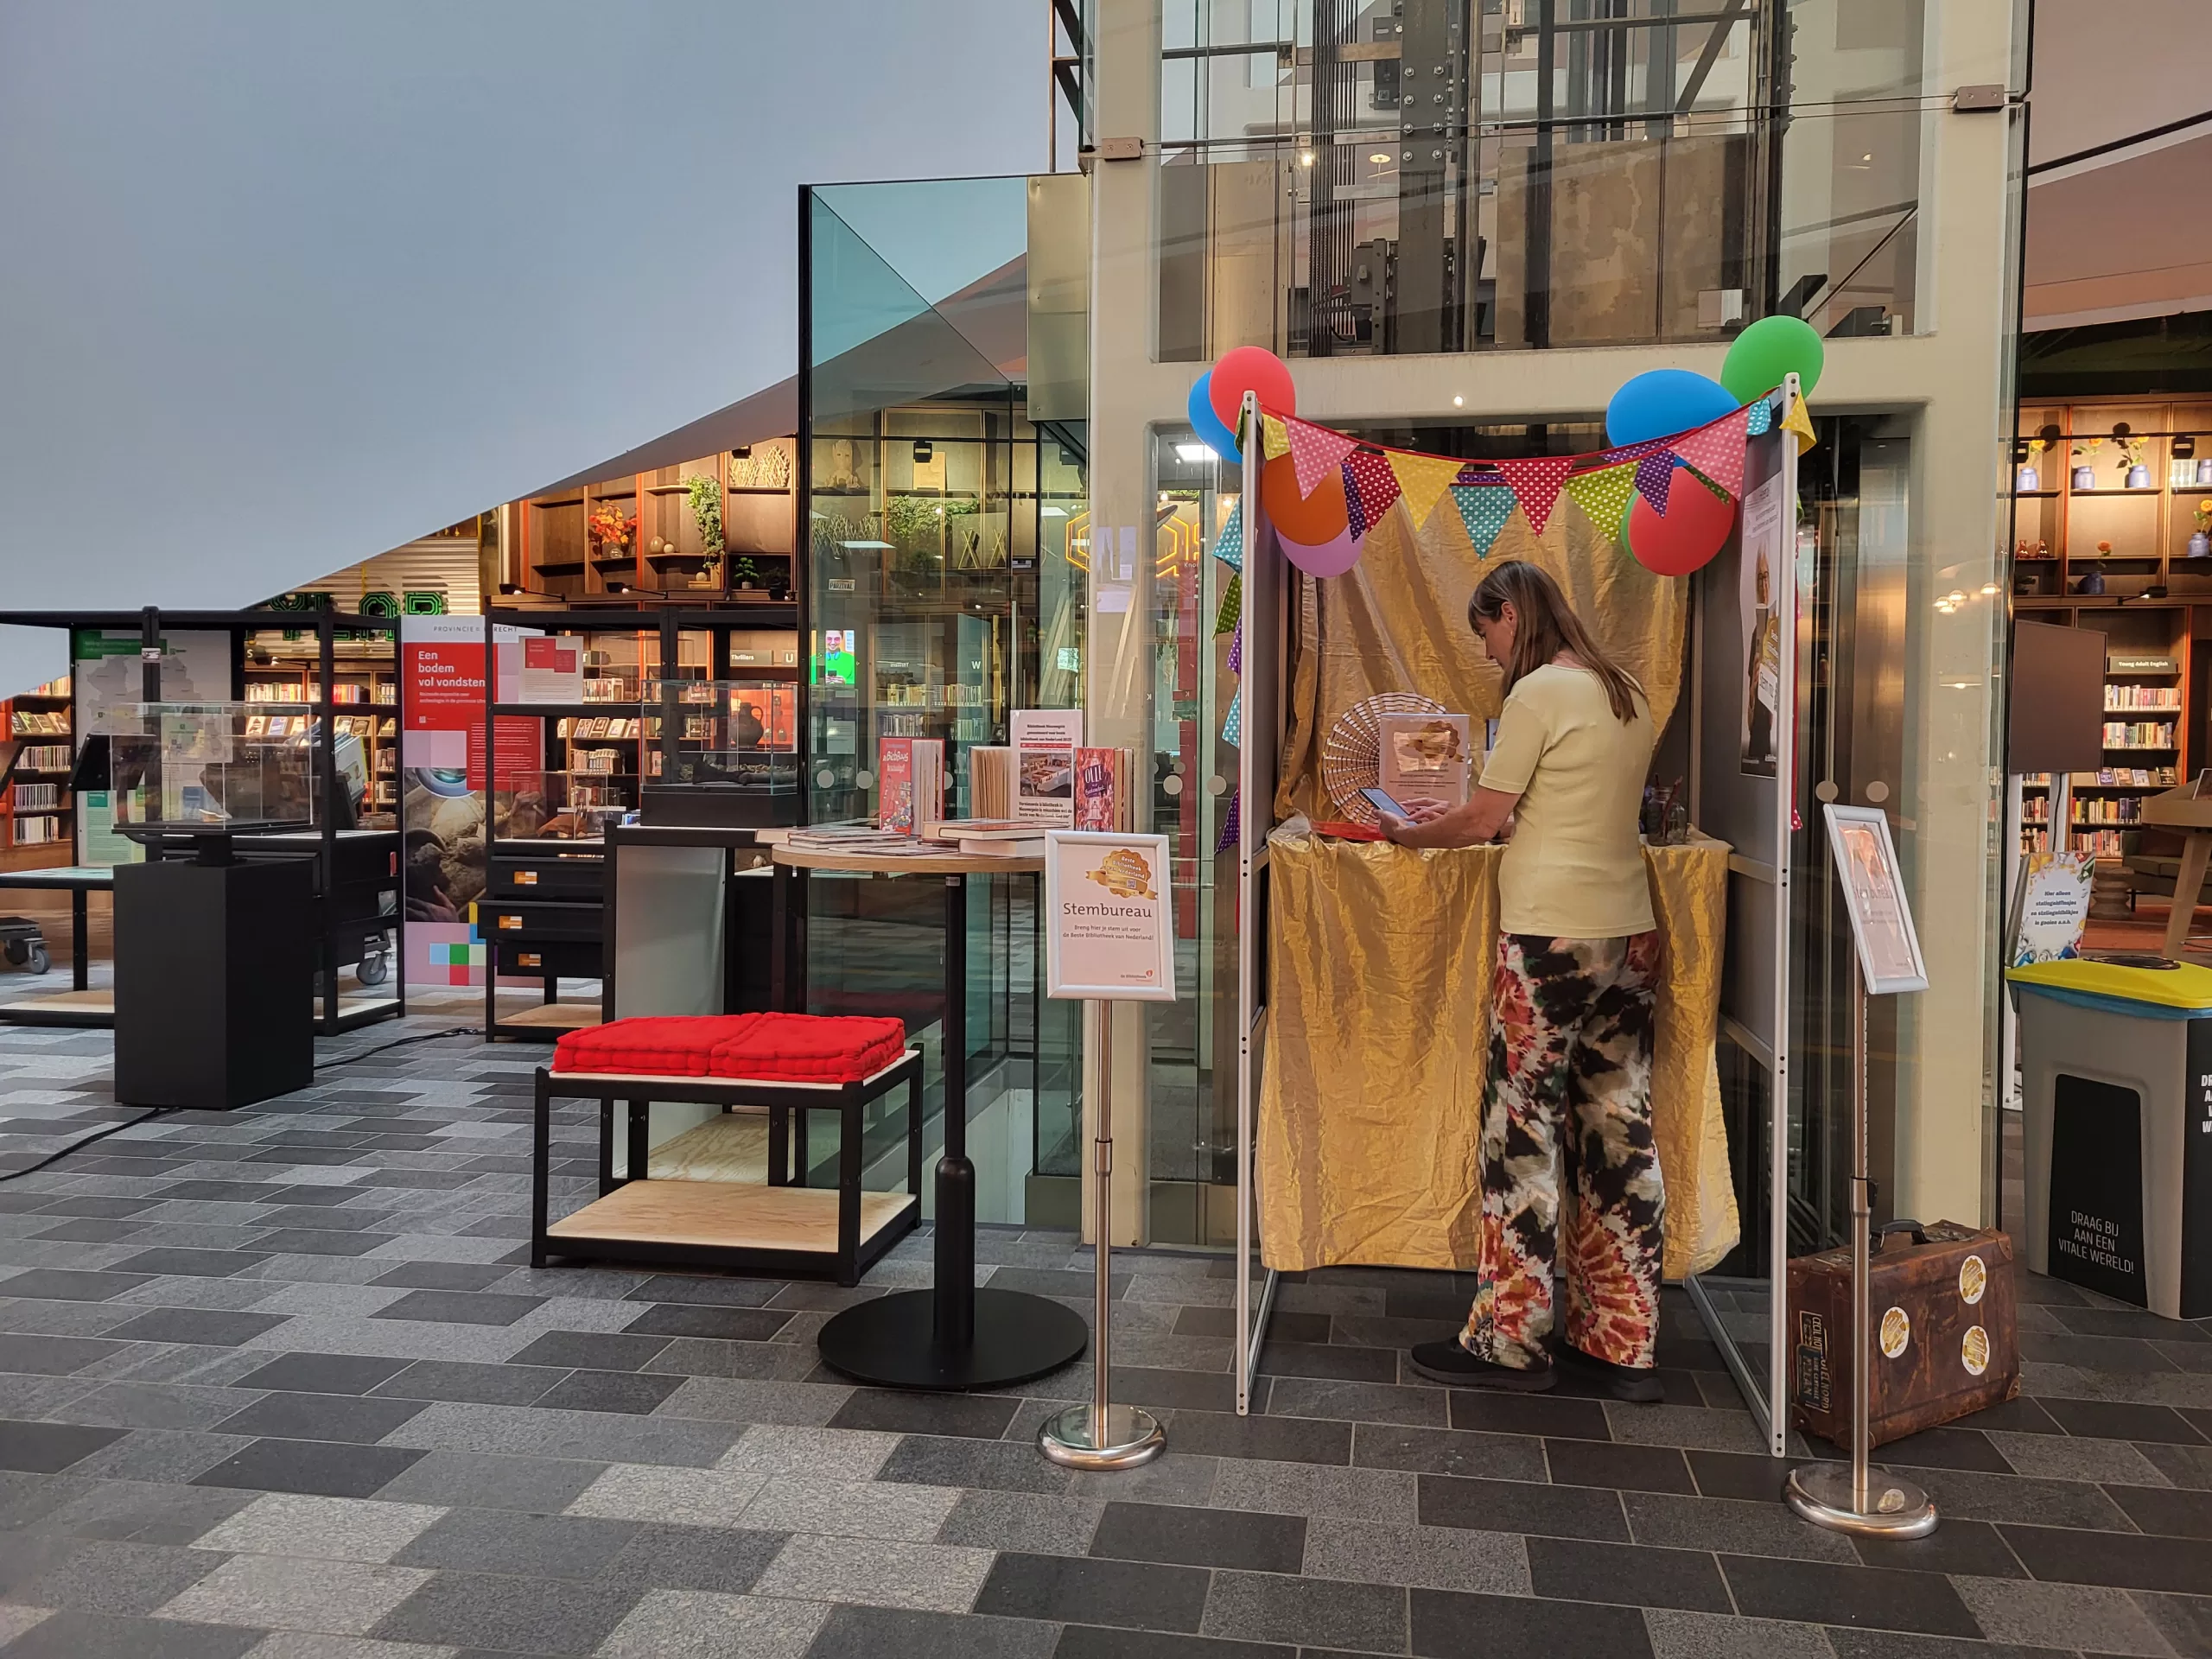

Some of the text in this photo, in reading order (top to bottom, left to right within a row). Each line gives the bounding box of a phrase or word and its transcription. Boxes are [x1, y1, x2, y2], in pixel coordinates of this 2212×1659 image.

[418, 651, 438, 660] Een
[785, 653, 794, 663] U
[418, 663, 454, 673] bodem
[971, 660, 982, 670] W
[418, 677, 486, 688] vol vondsten
[1118, 868, 1145, 879] Nederland
[1063, 902, 1153, 918] Stembureau
[2204, 1090, 2212, 1102] A
[2202, 1121, 2212, 1133] W
[2071, 1210, 2119, 1236] DRAAG BIJ
[2074, 1228, 2115, 1252] AAN EEN
[2058, 1237, 2134, 1274] VITALE WERELD!
[1821, 1382, 1830, 1408] NORD
